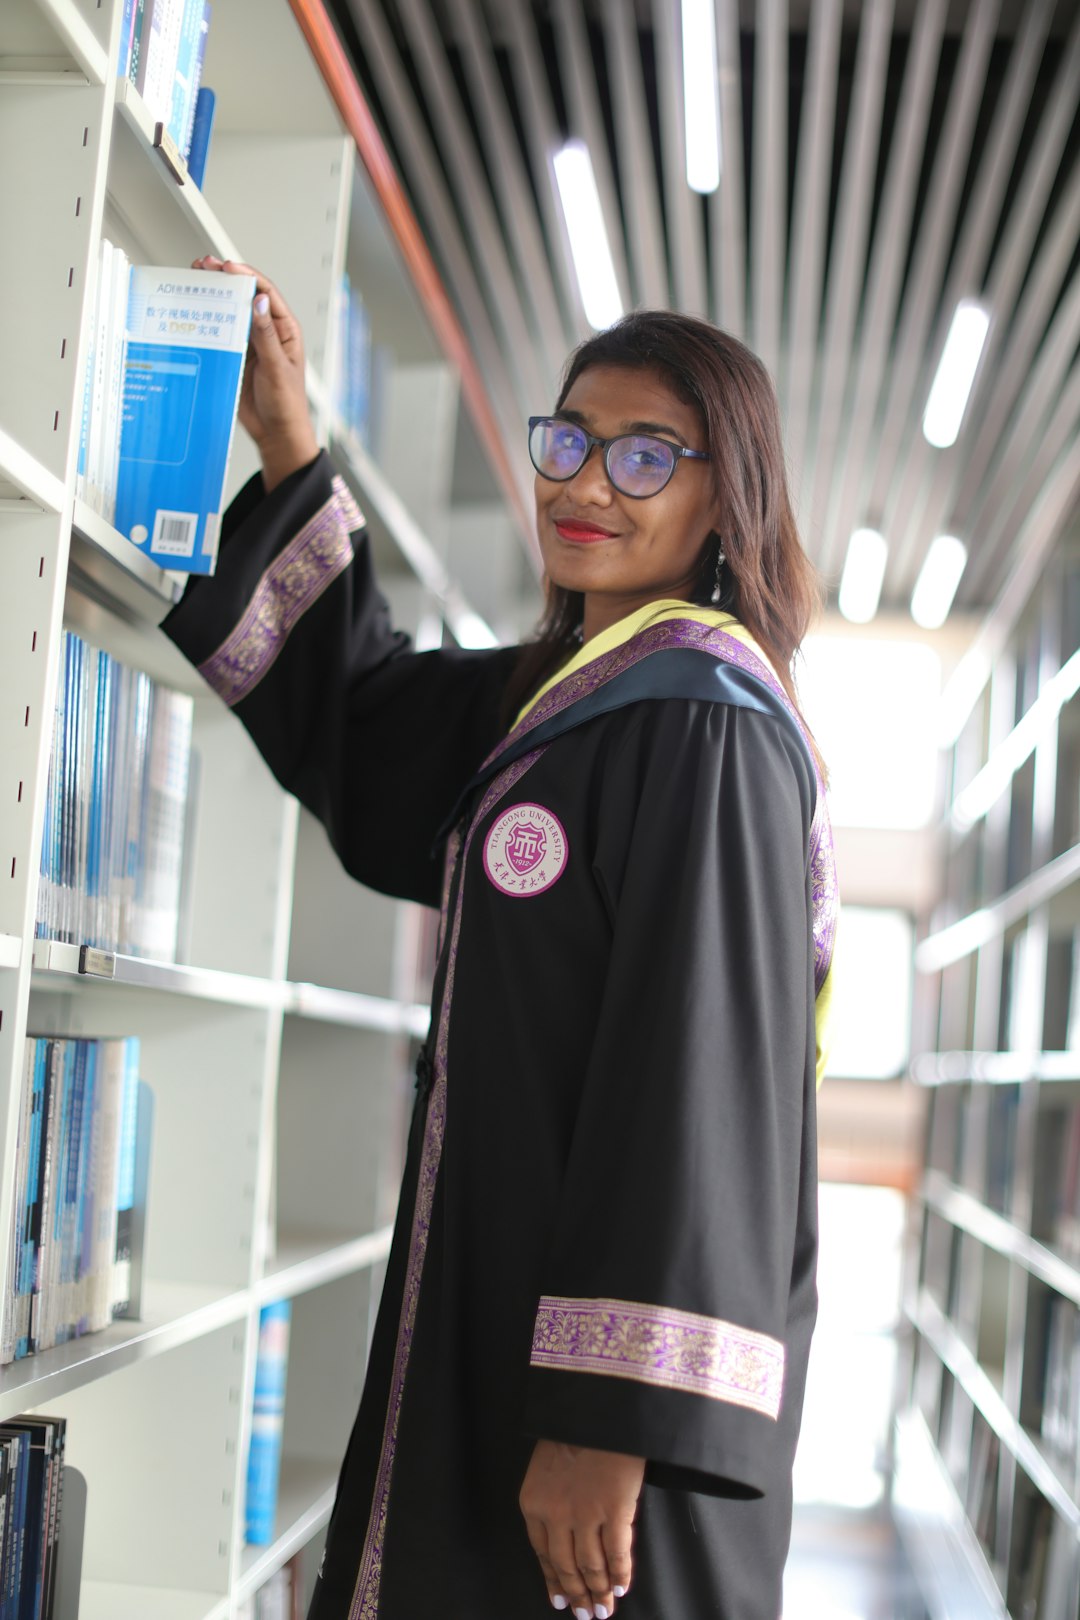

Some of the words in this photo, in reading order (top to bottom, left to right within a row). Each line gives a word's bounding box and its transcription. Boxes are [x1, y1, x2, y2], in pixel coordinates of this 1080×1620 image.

[146, 306, 237, 324] 数字视频处理原理
[491, 810, 526, 849] TIANGONG
[529, 810, 562, 863] UNIVERSITY
